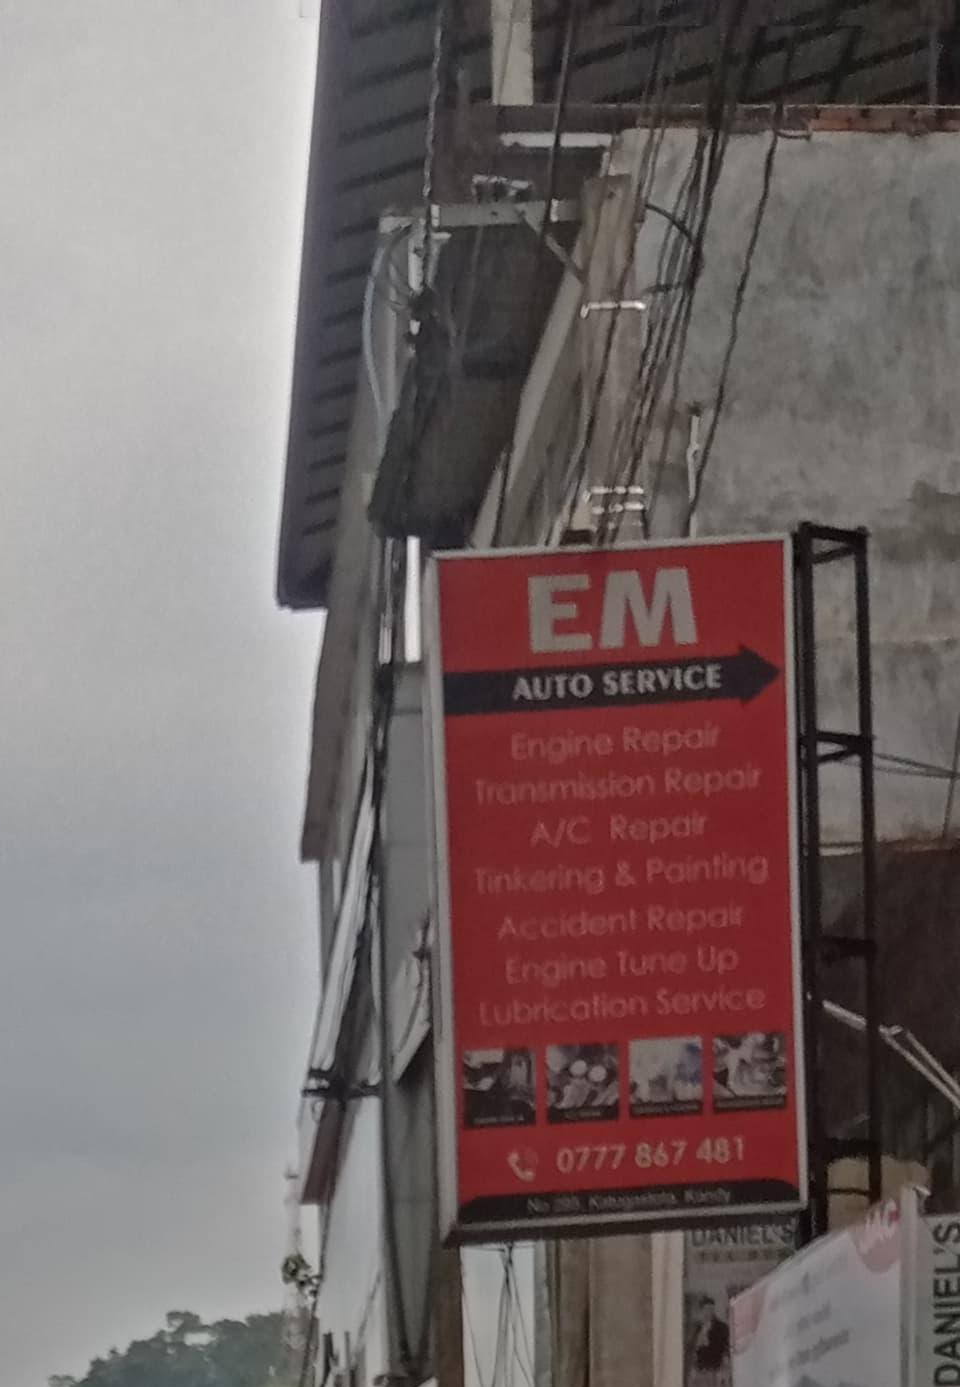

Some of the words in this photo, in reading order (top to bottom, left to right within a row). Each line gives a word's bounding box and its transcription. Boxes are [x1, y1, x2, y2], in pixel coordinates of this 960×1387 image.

[527, 567, 698, 654] EM
[512, 673, 593, 700] AUTO
[602, 664, 722, 695] SERVICE
[511, 729, 614, 764] Engine
[623, 720, 720, 755] Repair
[475, 772, 655, 805] Transmission
[665, 762, 762, 797] Repair
[530, 815, 590, 848] A/C
[609, 809, 708, 843] Repair
[474, 863, 605, 895] Tinkering
[614, 861, 636, 887] &
[646, 851, 769, 886] Painting
[498, 907, 638, 941] Accident
[647, 902, 744, 938] Repair
[505, 956, 607, 988] Engine
[617, 950, 688, 977] Tune
[697, 945, 739, 974] Up
[479, 991, 648, 1026] Lubrication
[656, 985, 767, 1016] Service
[556, 1143, 626, 1175] 0777
[634, 1140, 688, 1169] 867
[696, 1135, 746, 1165] 481
[933, 1222, 960, 1387] DANIEL'S
